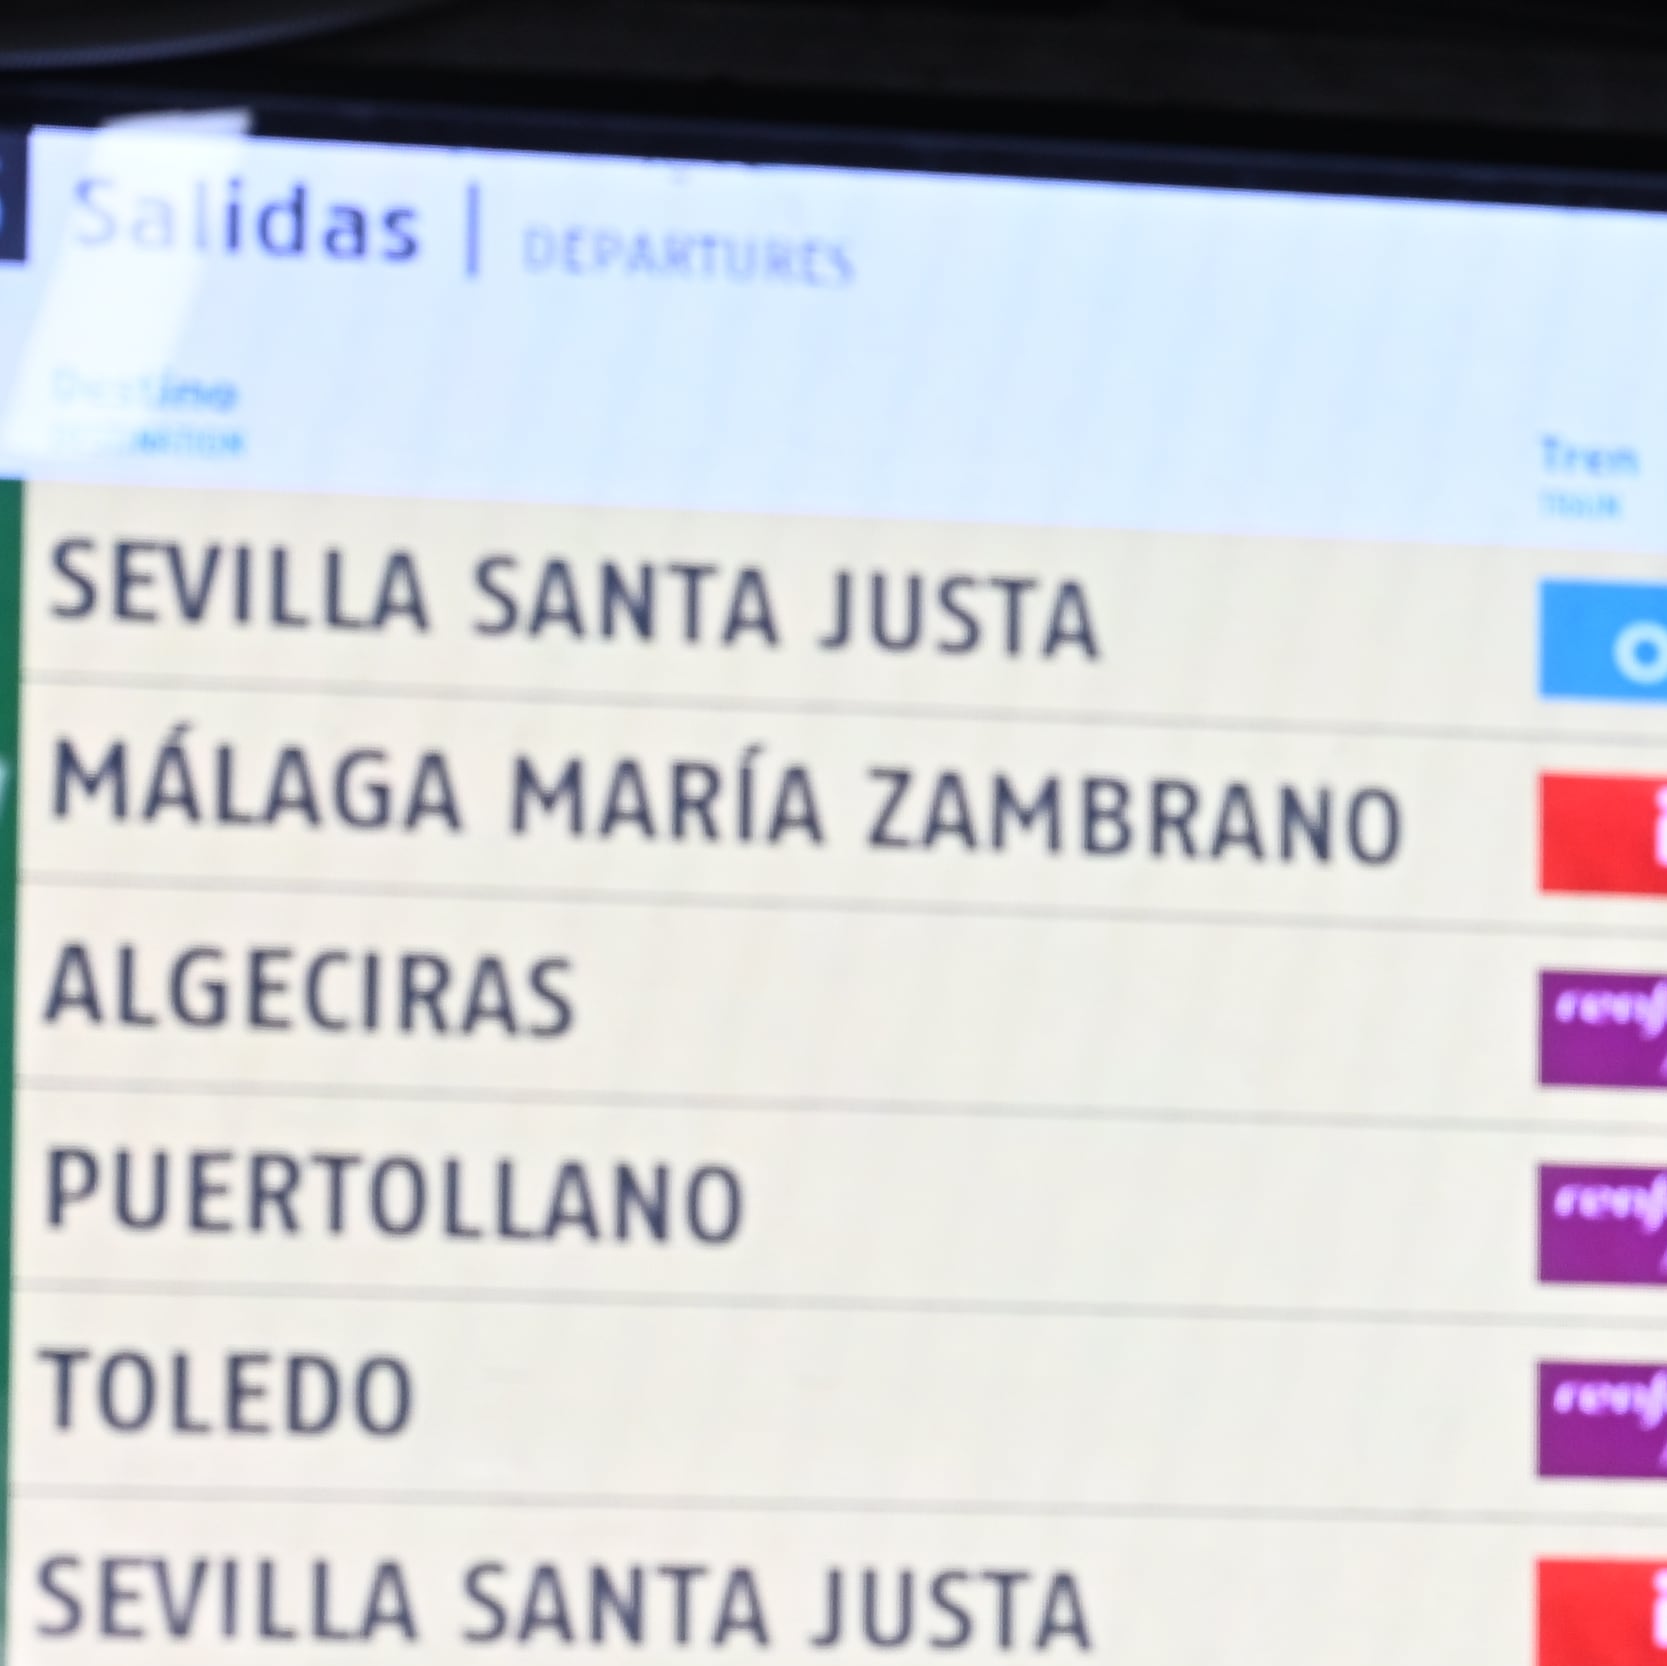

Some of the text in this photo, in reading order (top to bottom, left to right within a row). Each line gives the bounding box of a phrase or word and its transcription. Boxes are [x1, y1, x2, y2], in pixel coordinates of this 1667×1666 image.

[73, 176, 858, 290] Salidas DEPARTURES
[1538, 431, 1642, 478] Tren
[50, 536, 1102, 663] SEVILLA SANTA JUSTA
[51, 722, 1403, 868] MÁLAGA MARÍA ZAMBRANO
[41, 940, 575, 1041] ALGECIRAS
[46, 1144, 745, 1247] PUERTOLLANO
[36, 1346, 414, 1439] TOLEDO
[36, 1553, 1094, 1653] SEVILLA SANTA JUSTA
